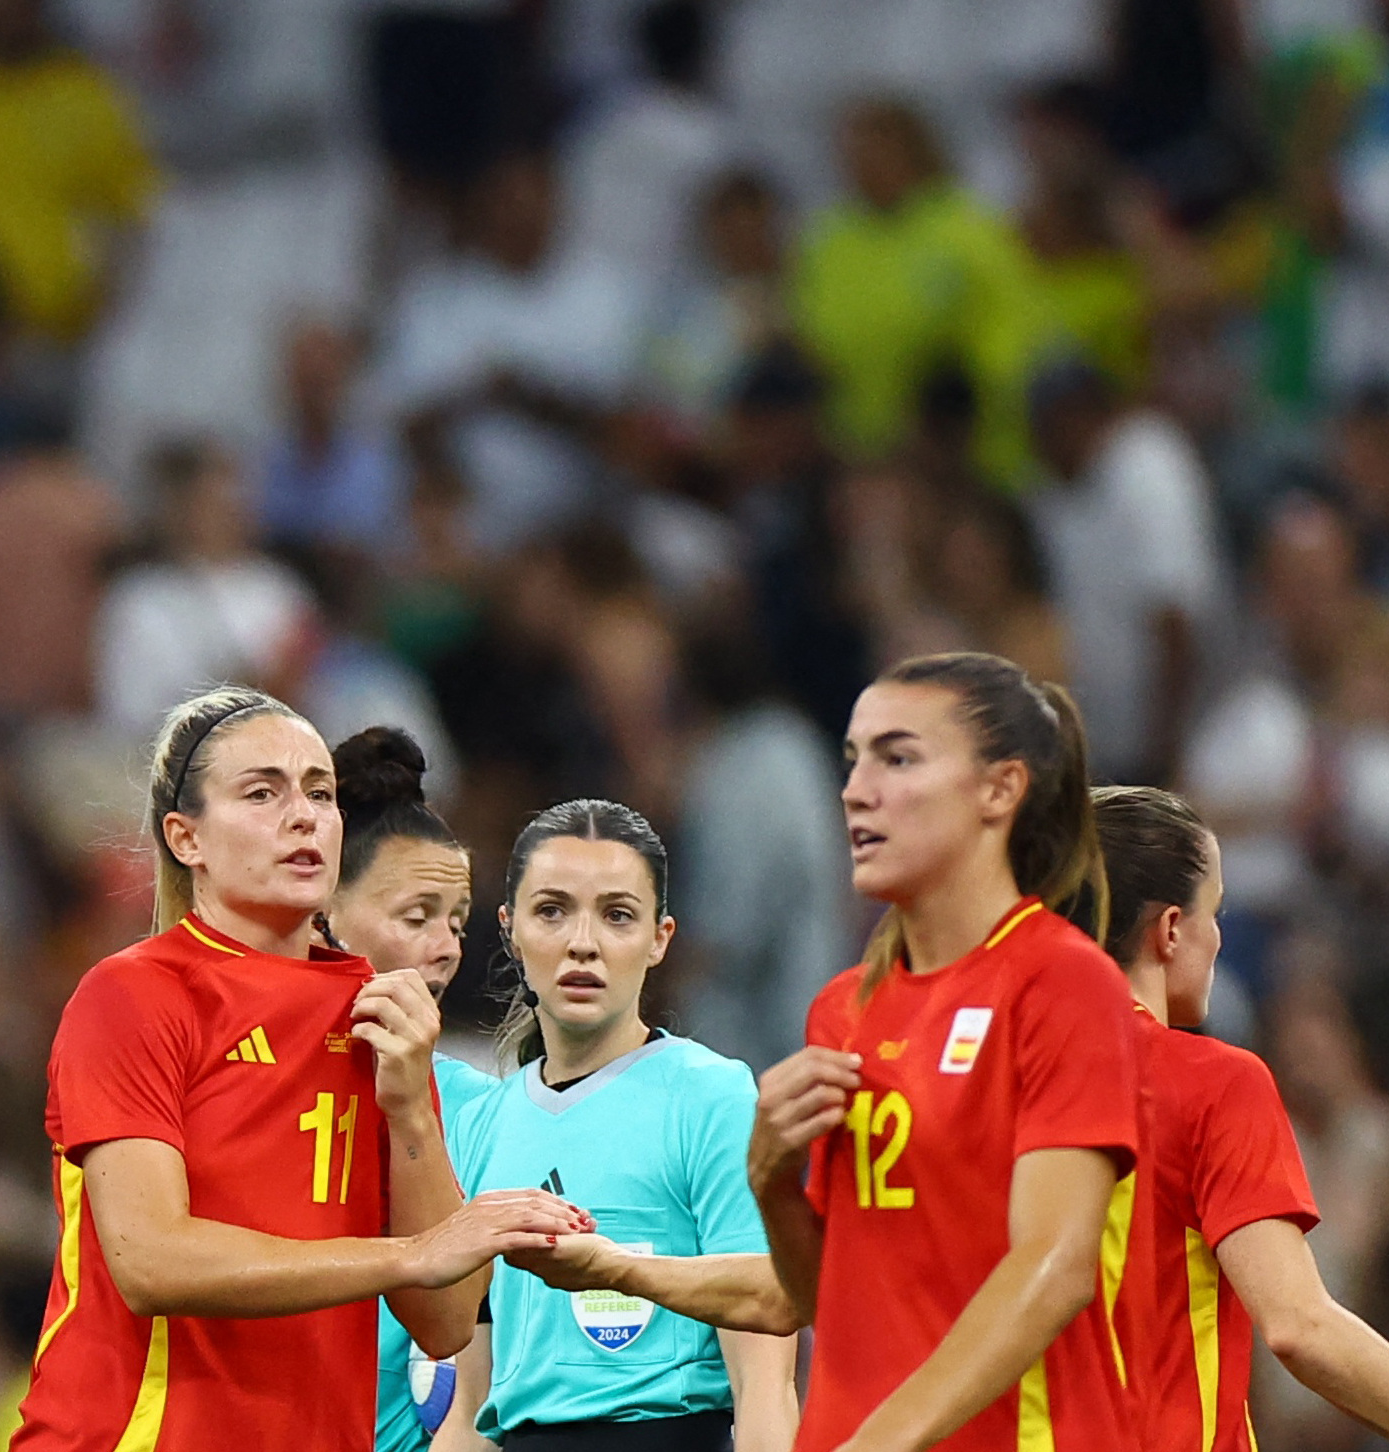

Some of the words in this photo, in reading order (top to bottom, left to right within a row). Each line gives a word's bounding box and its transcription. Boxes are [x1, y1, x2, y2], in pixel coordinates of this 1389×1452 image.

[299, 1091, 359, 1205] 11
[846, 1090, 916, 1209] 12
[584, 1301, 642, 1313] REFEREE
[597, 1328, 630, 1341] 2024
